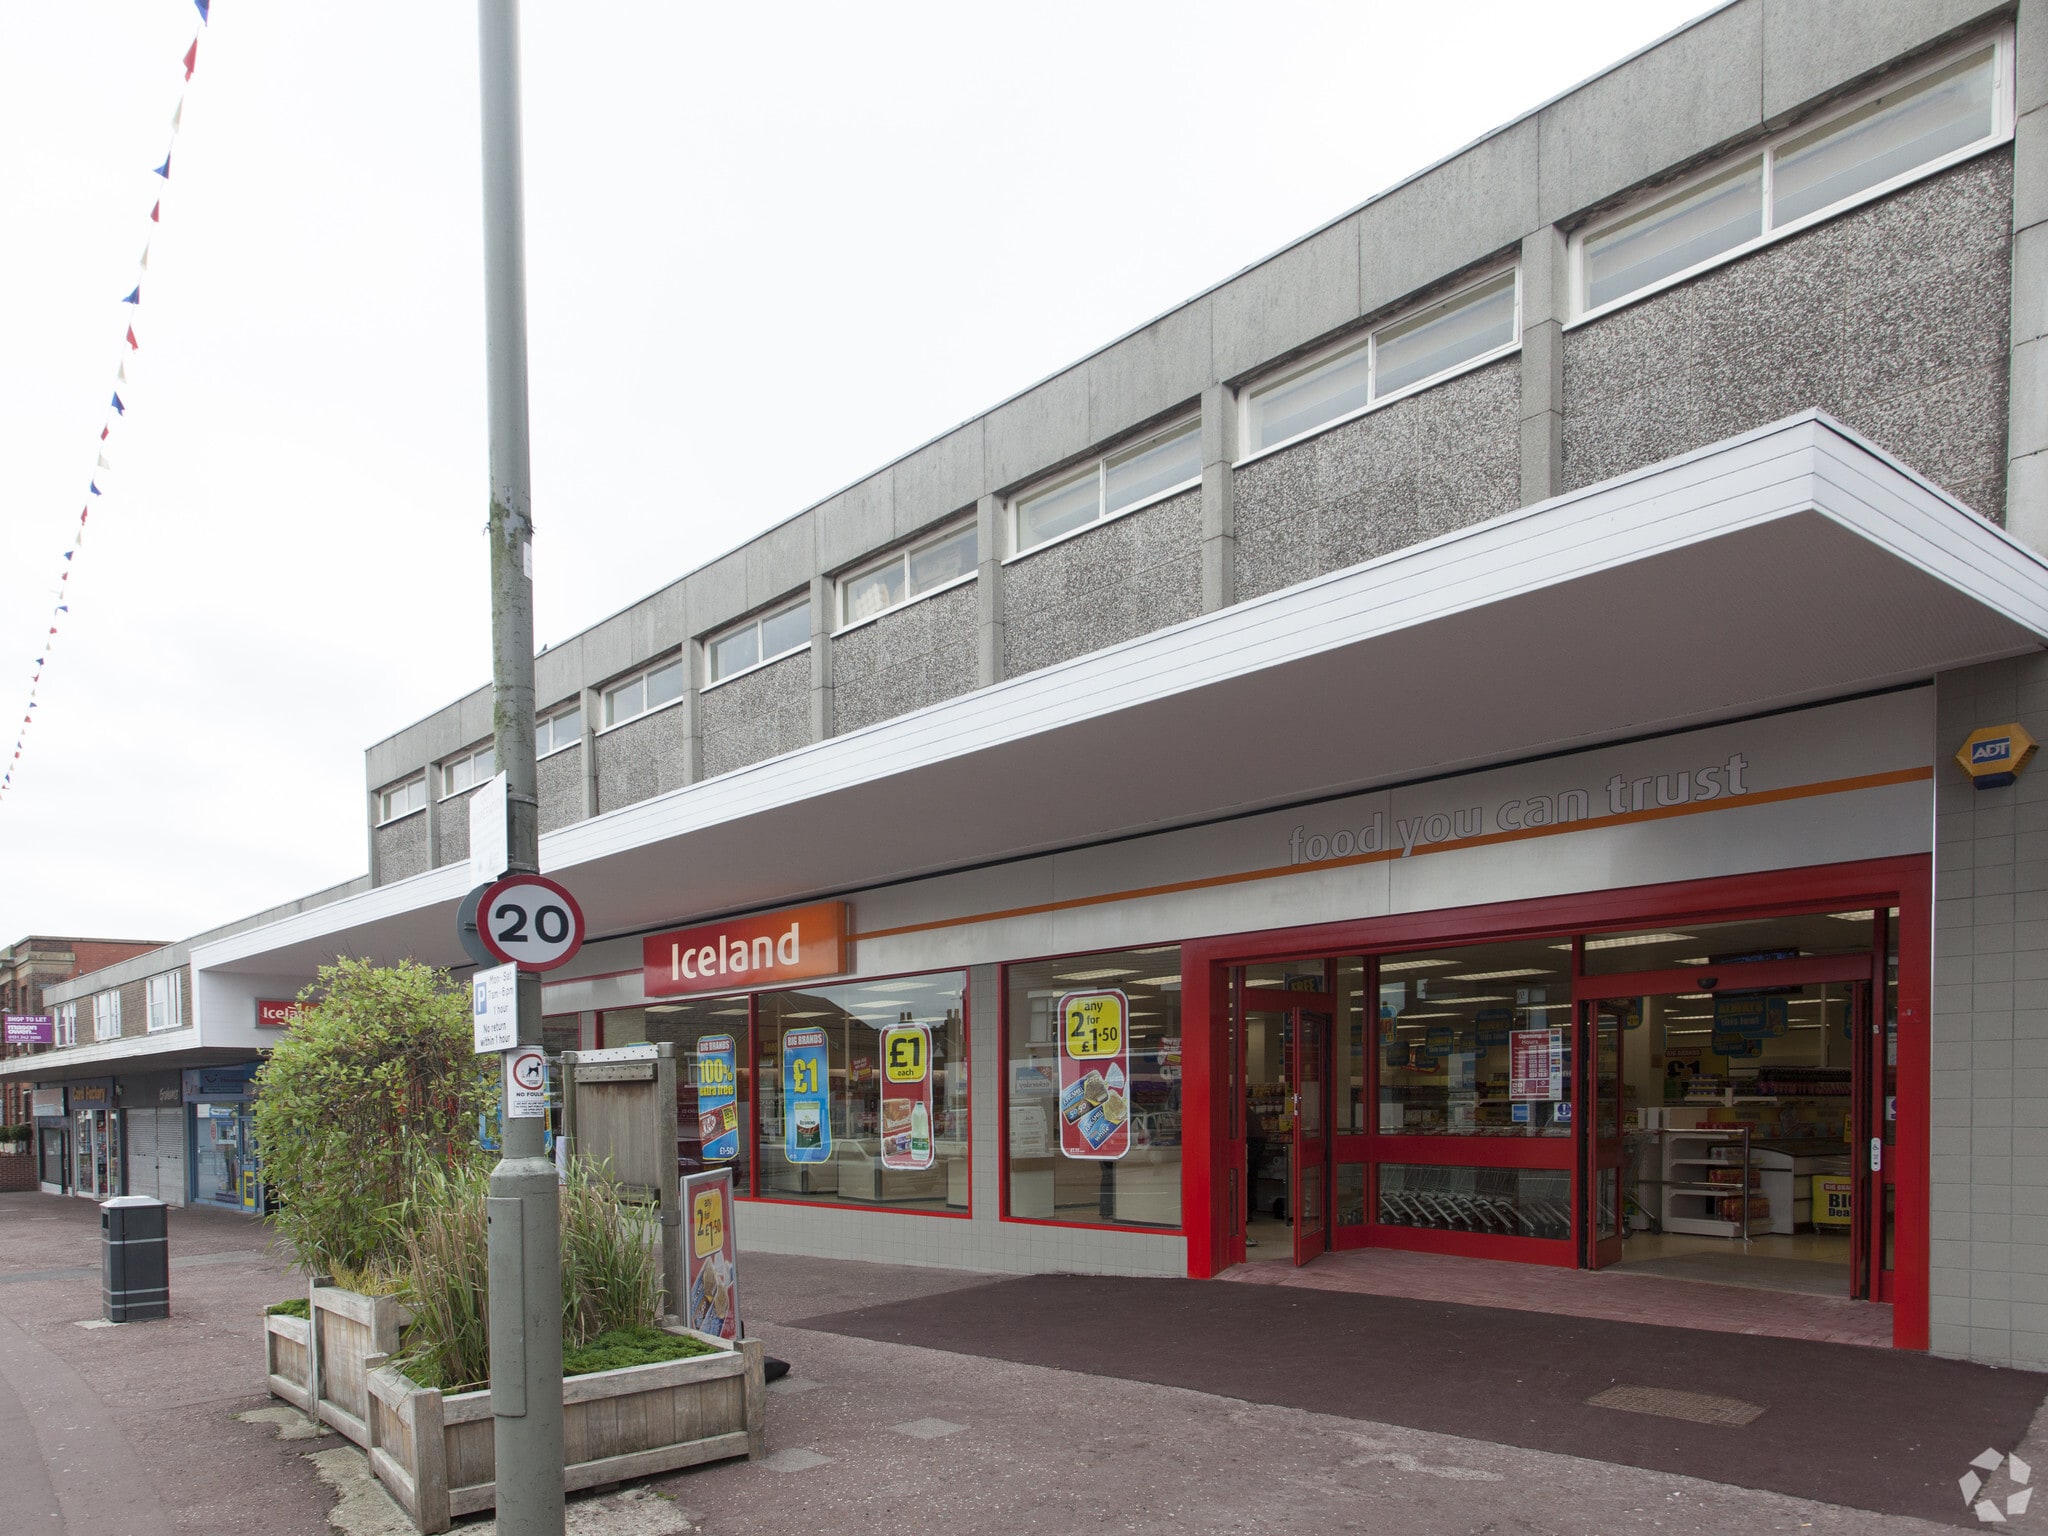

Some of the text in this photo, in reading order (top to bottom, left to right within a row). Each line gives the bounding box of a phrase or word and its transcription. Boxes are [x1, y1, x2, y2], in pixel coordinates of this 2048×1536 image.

[1972, 742, 2010, 760] ADT
[1289, 753, 1748, 866] food you can trust
[495, 904, 569, 943] 20
[672, 922, 800, 981] Iceland
[263, 1006, 304, 1020] Icela
[1084, 1001, 1103, 1013] any
[1071, 1012, 1085, 1038] 2
[1087, 1014, 1100, 1025] for
[709, 1040, 731, 1050] BRANDS
[788, 1033, 823, 1046] BIG BRANDS
[889, 1037, 920, 1068] £1
[700, 1059, 734, 1085] 100%
[793, 1058, 818, 1093] £1
[897, 1069, 914, 1077] each
[699, 1084, 735, 1097] extra free
[697, 1209, 704, 1237] 2
[1828, 1207, 1851, 1217] Dea
